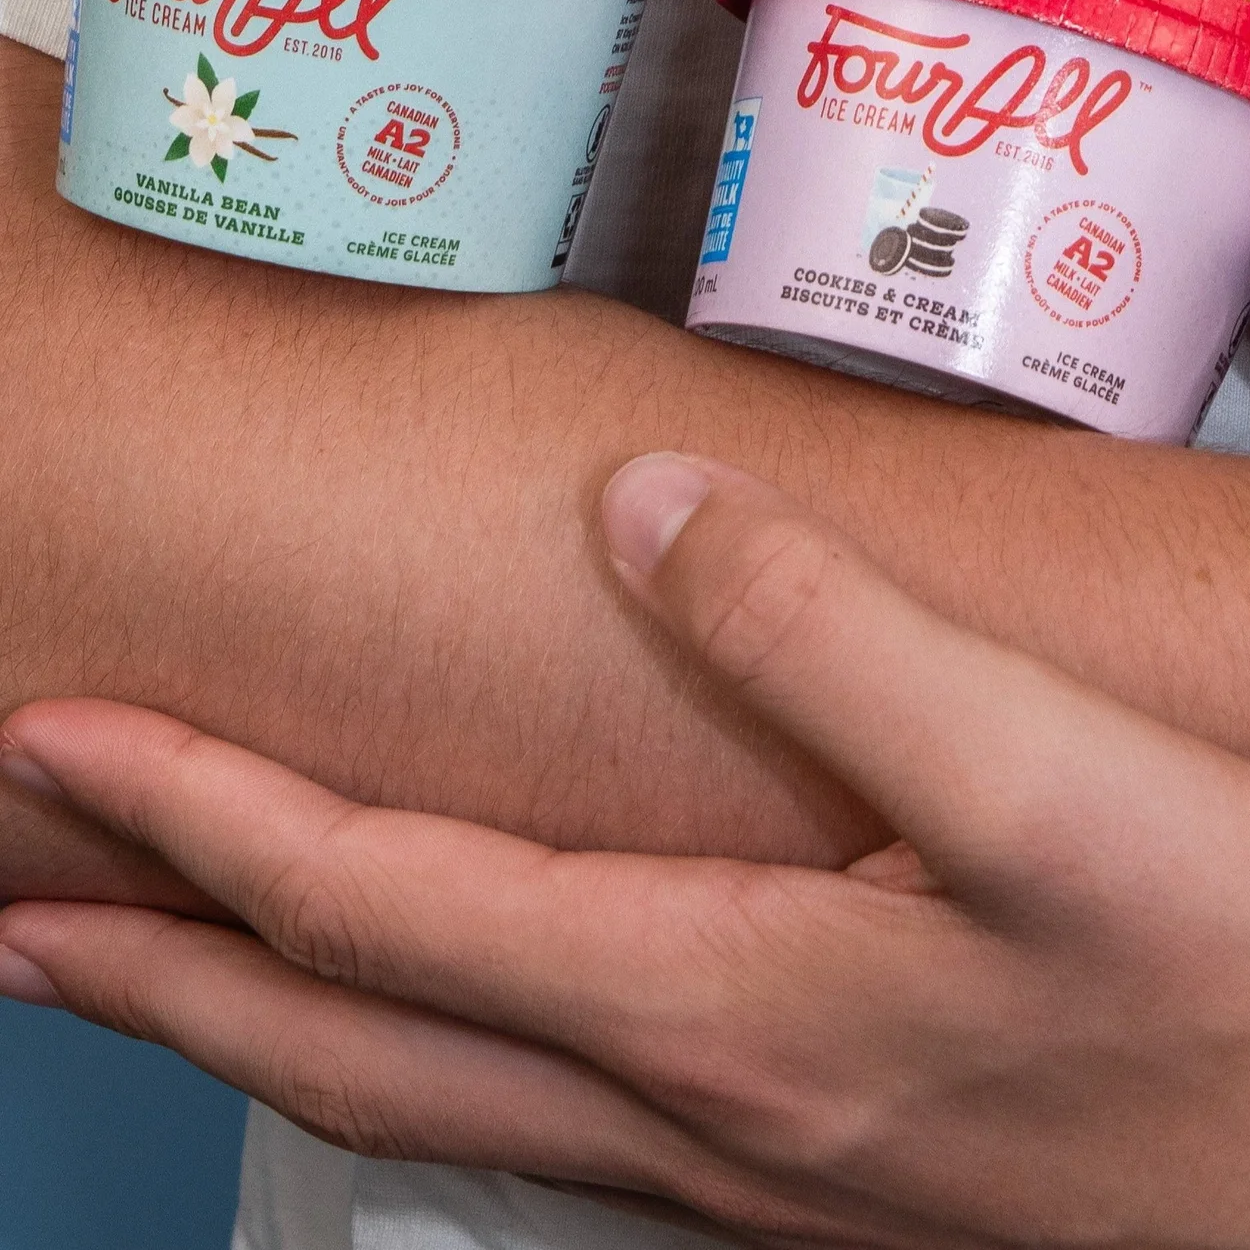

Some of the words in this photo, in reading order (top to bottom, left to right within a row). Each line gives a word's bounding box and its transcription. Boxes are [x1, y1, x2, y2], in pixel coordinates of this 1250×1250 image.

[152, 3, 206, 37] CREAM
[350, 105, 357, 114] A
[356, 87, 385, 107] TASTE
[388, 84, 401, 92] OF
[404, 84, 424, 93] JOY
[425, 88, 443, 104] FOR
[442, 102, 461, 150] EVERYONE
[387, 100, 439, 129] CANADIAN
[820, 97, 847, 122] ICE
[853, 104, 916, 136] CREAM
[374, 118, 431, 159] A2
[337, 126, 346, 140] UN
[371, 194, 383, 205] DE
[385, 198, 407, 207] JOIE
[410, 186, 435, 204] POUR
[435, 163, 454, 188] TOUS
[362, 160, 413, 189] CANADIEN
[367, 146, 392, 164] MILK
[397, 157, 420, 174] LAIT
[114, 187, 178, 218] GOUSSE
[183, 206, 209, 225] DE
[215, 213, 305, 245] VANILLE
[136, 173, 214, 206] VANILLA
[221, 197, 281, 221] BEAN
[347, 241, 398, 259] CRÈME
[404, 249, 456, 266] GLACÉE
[382, 231, 406, 245] ICE
[411, 235, 460, 250] CREAM
[780, 286, 870, 317] BISCUITS
[875, 307, 903, 323] ET
[794, 267, 876, 297] COOKIES
[883, 287, 897, 303] &
[903, 292, 983, 327] CREAM
